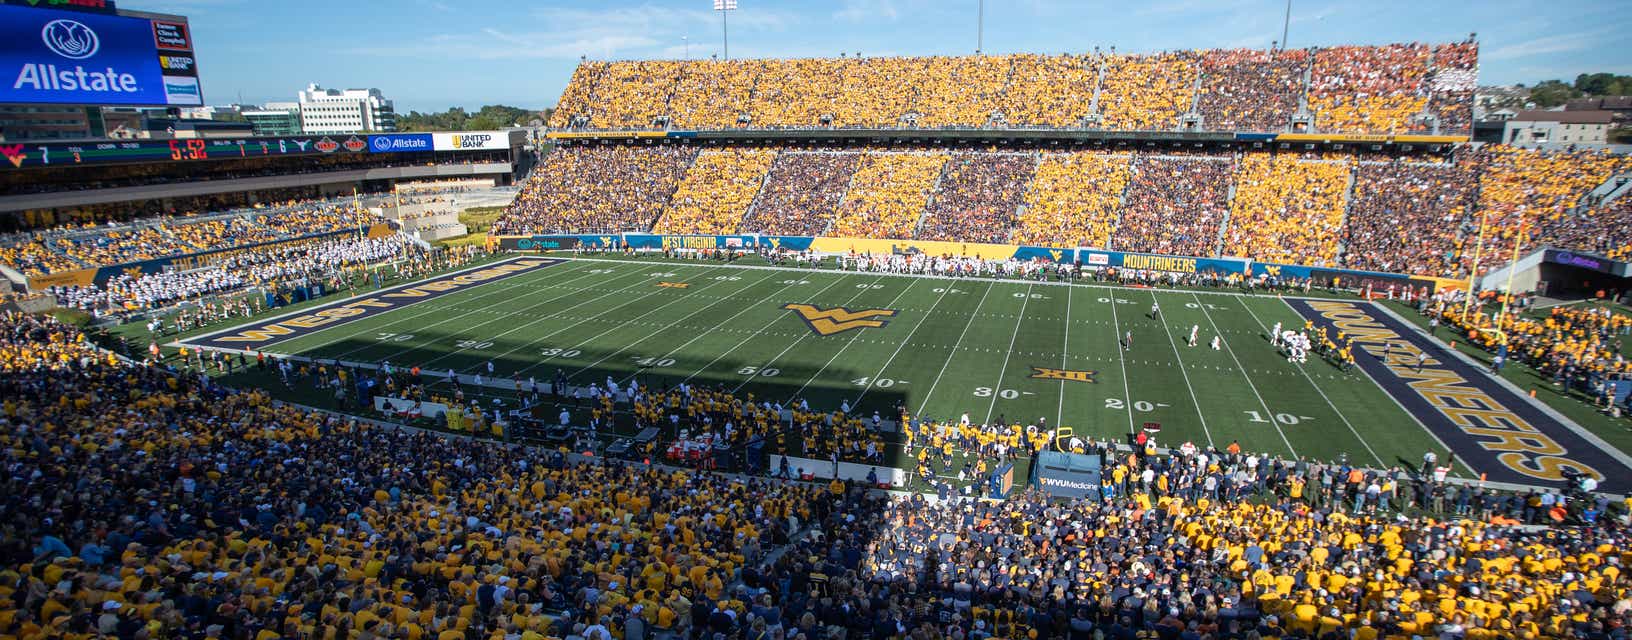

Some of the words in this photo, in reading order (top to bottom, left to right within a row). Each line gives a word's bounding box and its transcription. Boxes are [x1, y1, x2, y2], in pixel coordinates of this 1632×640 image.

[14, 63, 137, 92] Allstate
[392, 138, 426, 148] Allstate
[461, 134, 491, 142] UNITED
[169, 139, 207, 160] 5:52
[279, 140, 287, 153] 6
[462, 141, 485, 149] BANK
[38, 146, 49, 164] 7
[662, 236, 682, 249] WEST
[683, 236, 717, 249] VIRGINIA
[1123, 254, 1197, 273] MOUNTAINEERS
[213, 297, 394, 342] WEST
[376, 332, 414, 342] 10
[456, 340, 494, 349] 20
[542, 348, 582, 358] 30
[636, 356, 676, 367] 40
[737, 366, 780, 377] 50
[851, 376, 895, 388] 40
[973, 386, 1019, 400] 30
[1304, 300, 1606, 481] MOUNTAINEERS
[1104, 398, 1154, 412] 20
[1243, 410, 1300, 425] 10
